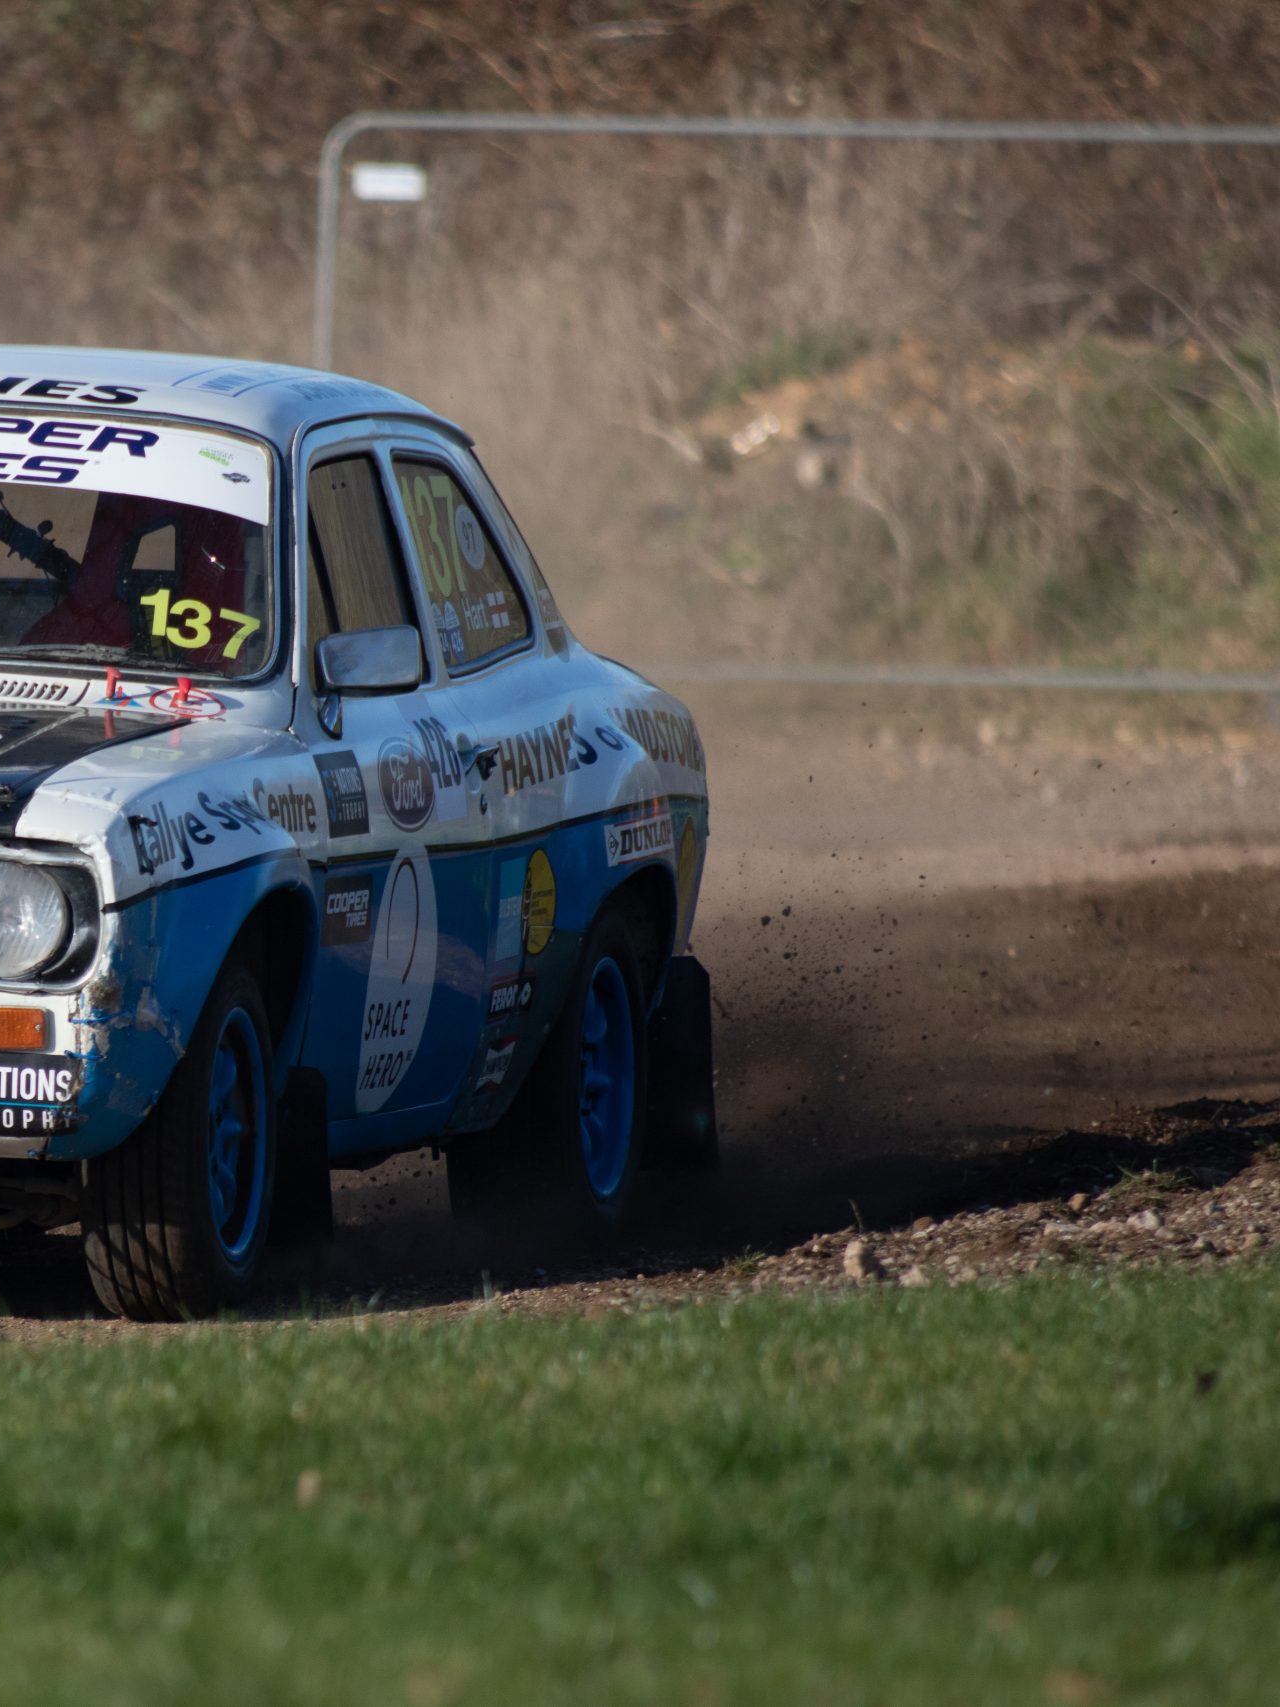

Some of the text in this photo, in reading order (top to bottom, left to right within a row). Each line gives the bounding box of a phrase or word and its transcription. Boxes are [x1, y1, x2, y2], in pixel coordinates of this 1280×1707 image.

[401, 475, 466, 598] 137
[140, 588, 261, 660] 137
[412, 716, 462, 789] 426
[498, 713, 598, 795] HAYNES
[388, 753, 426, 812] Ford
[128, 800, 215, 875] Rallye
[620, 820, 672, 856] DUNLOP
[327, 889, 370, 915] COOPER
[345, 911, 368, 928] TIRES
[364, 1000, 412, 1041] SPACE
[358, 1050, 405, 1091] HERO
